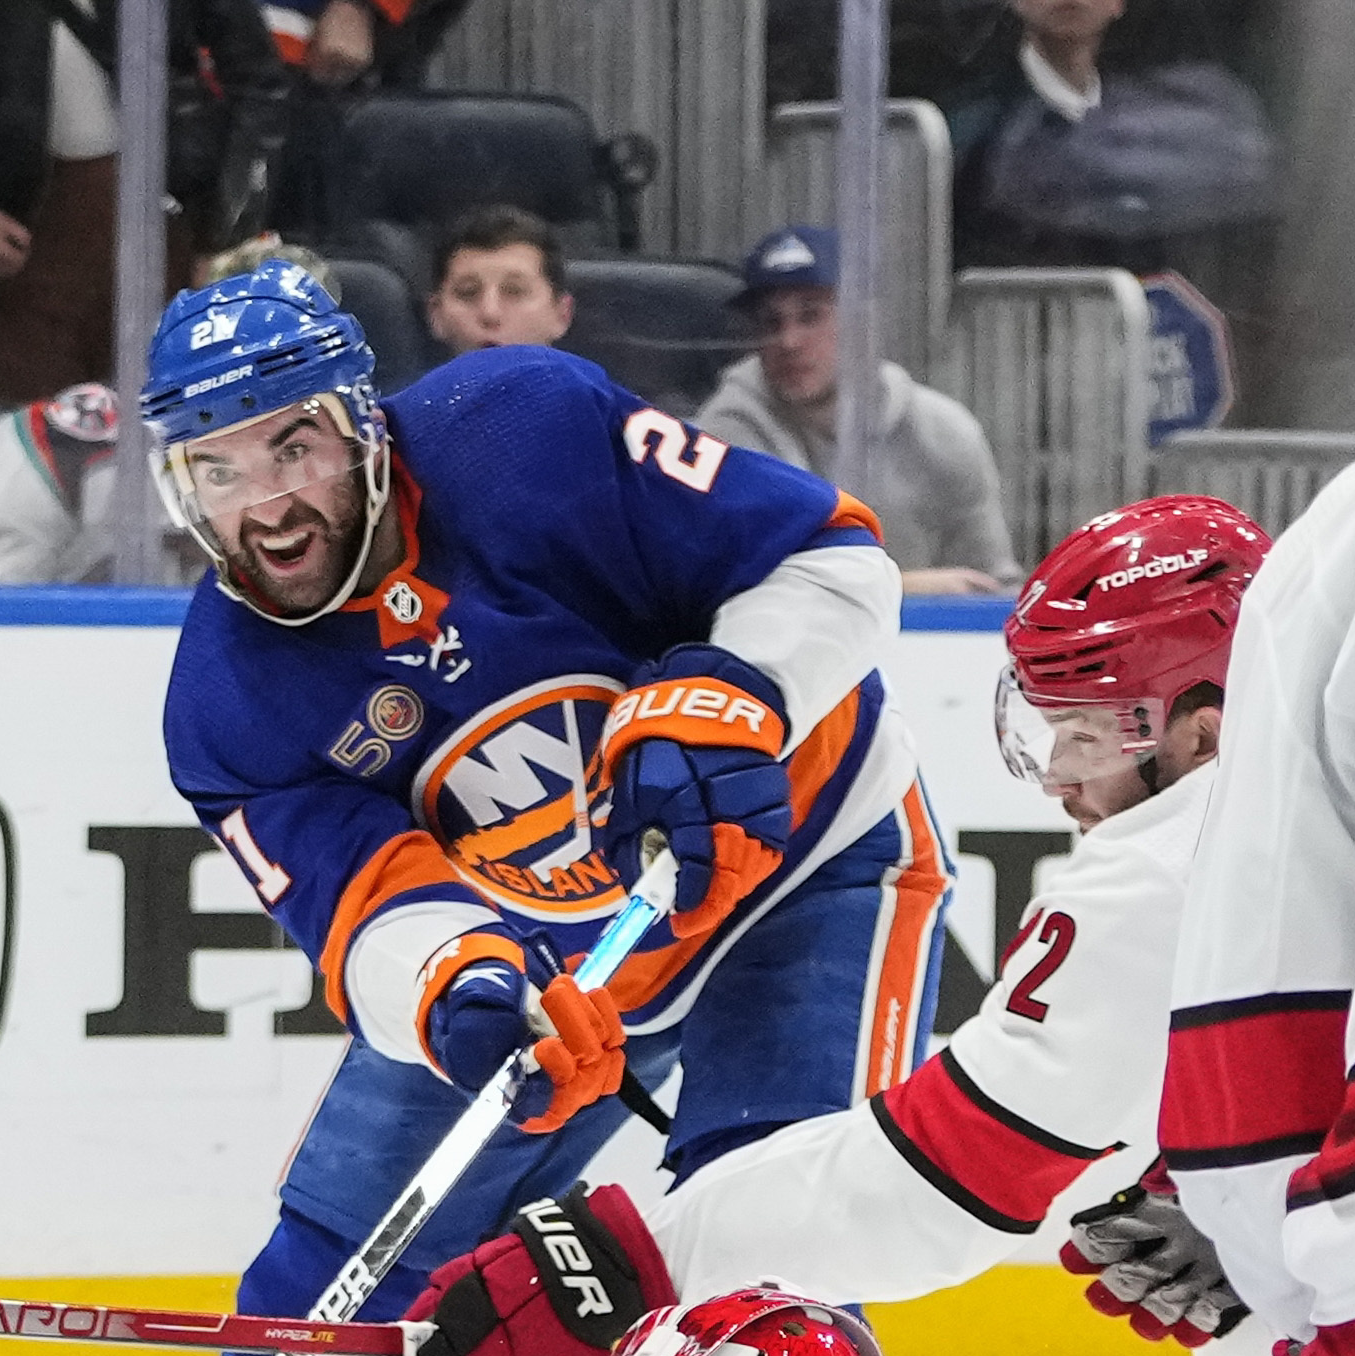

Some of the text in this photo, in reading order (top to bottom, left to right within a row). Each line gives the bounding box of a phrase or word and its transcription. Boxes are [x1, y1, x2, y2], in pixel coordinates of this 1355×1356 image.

[183, 364, 254, 399] BAUER
[1097, 549, 1208, 592] TOPGOLF
[483, 848, 620, 897] ISLAN
[999, 906, 1076, 1023] 2
[518, 1197, 615, 1318] UER
[265, 1328, 336, 1343] HYPERLITE
